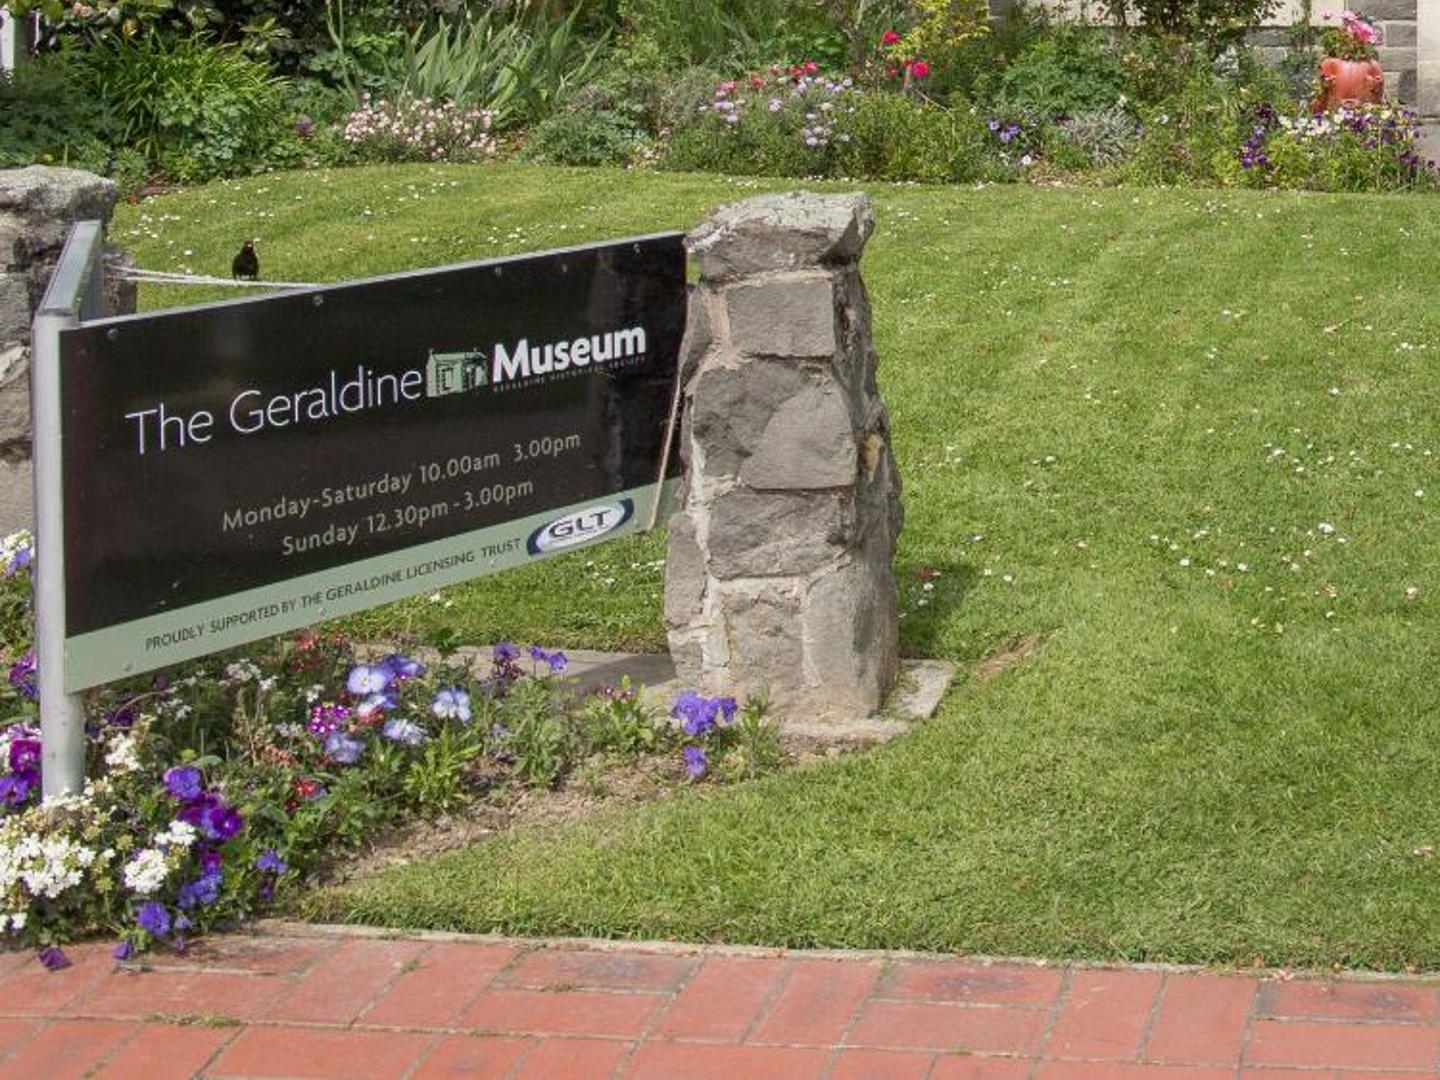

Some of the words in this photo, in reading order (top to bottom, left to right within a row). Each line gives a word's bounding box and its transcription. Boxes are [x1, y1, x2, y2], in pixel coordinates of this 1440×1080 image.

[125, 402, 214, 455] The
[229, 365, 423, 433] Geraldine
[492, 326, 647, 383] Museum
[222, 468, 412, 532] Monday-Saturday
[420, 450, 500, 485] 10.00am
[513, 432, 581, 463] 3.00pm
[281, 522, 359, 556] Sunday
[367, 499, 449, 535] 12.30pm
[464, 477, 534, 511] 3.00pm
[548, 510, 612, 538] GLT
[145, 623, 206, 652] PROUDLY
[209, 603, 278, 634] SUPPORTED
[281, 599, 298, 614] BY
[301, 592, 323, 608] THE
[326, 569, 402, 601] GERALDINE
[405, 550, 476, 580] LICENSING
[480, 538, 521, 559] TRUST
